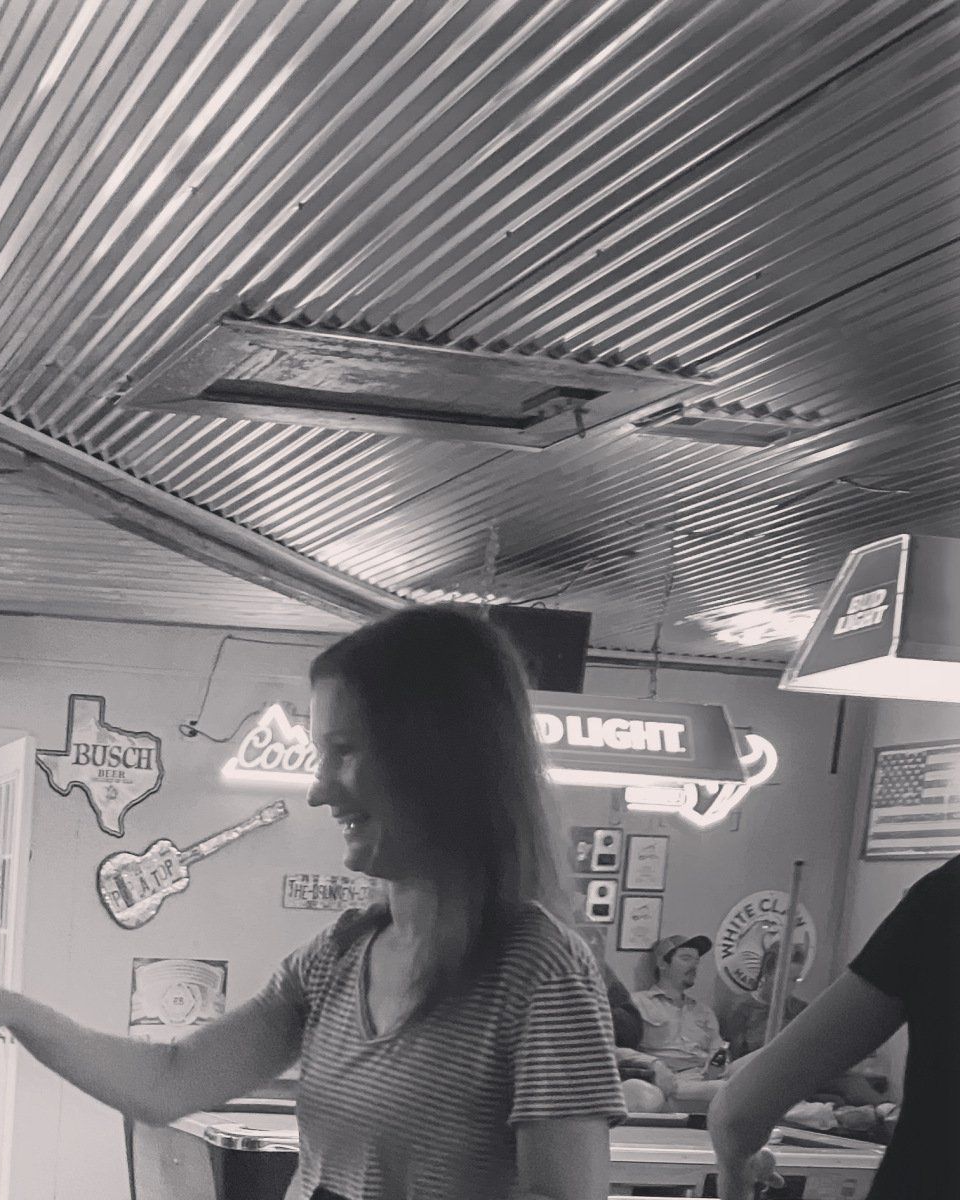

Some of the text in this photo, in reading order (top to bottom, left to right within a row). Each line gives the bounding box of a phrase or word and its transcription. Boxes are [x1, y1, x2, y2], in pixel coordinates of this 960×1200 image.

[846, 588, 888, 615] BUD
[832, 605, 890, 635] LIGHT
[565, 714, 687, 752] LIGHT
[72, 743, 154, 770] BUSCH
[97, 769, 126, 779] BEER
[721, 903, 756, 960] WHITE
